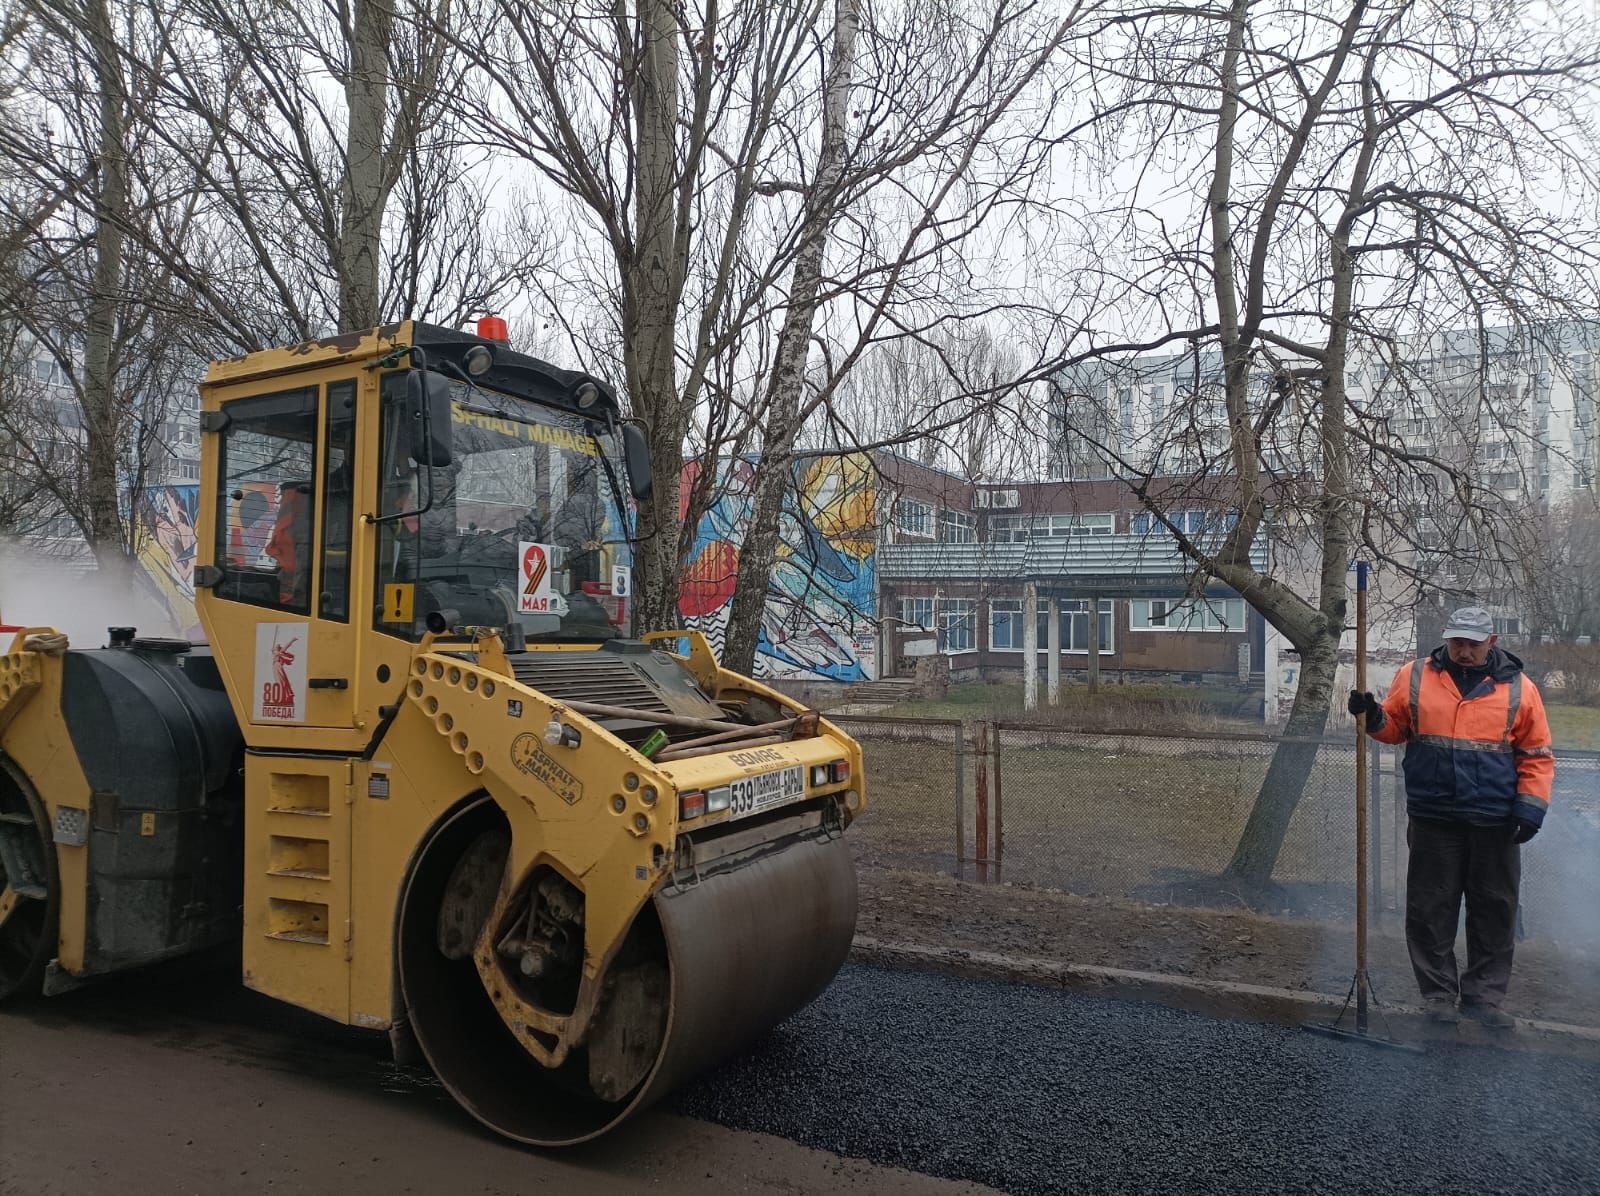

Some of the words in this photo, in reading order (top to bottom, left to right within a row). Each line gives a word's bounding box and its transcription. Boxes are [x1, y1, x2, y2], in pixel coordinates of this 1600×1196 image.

[450, 399, 520, 437] SPHALT
[522, 597, 548, 611] МАЯ
[263, 682, 281, 703] 80
[262, 706, 295, 719] ПОБЕДА!
[530, 748, 576, 786] ASPHALT
[728, 748, 784, 767] BOMAG
[731, 780, 753, 815] 539
